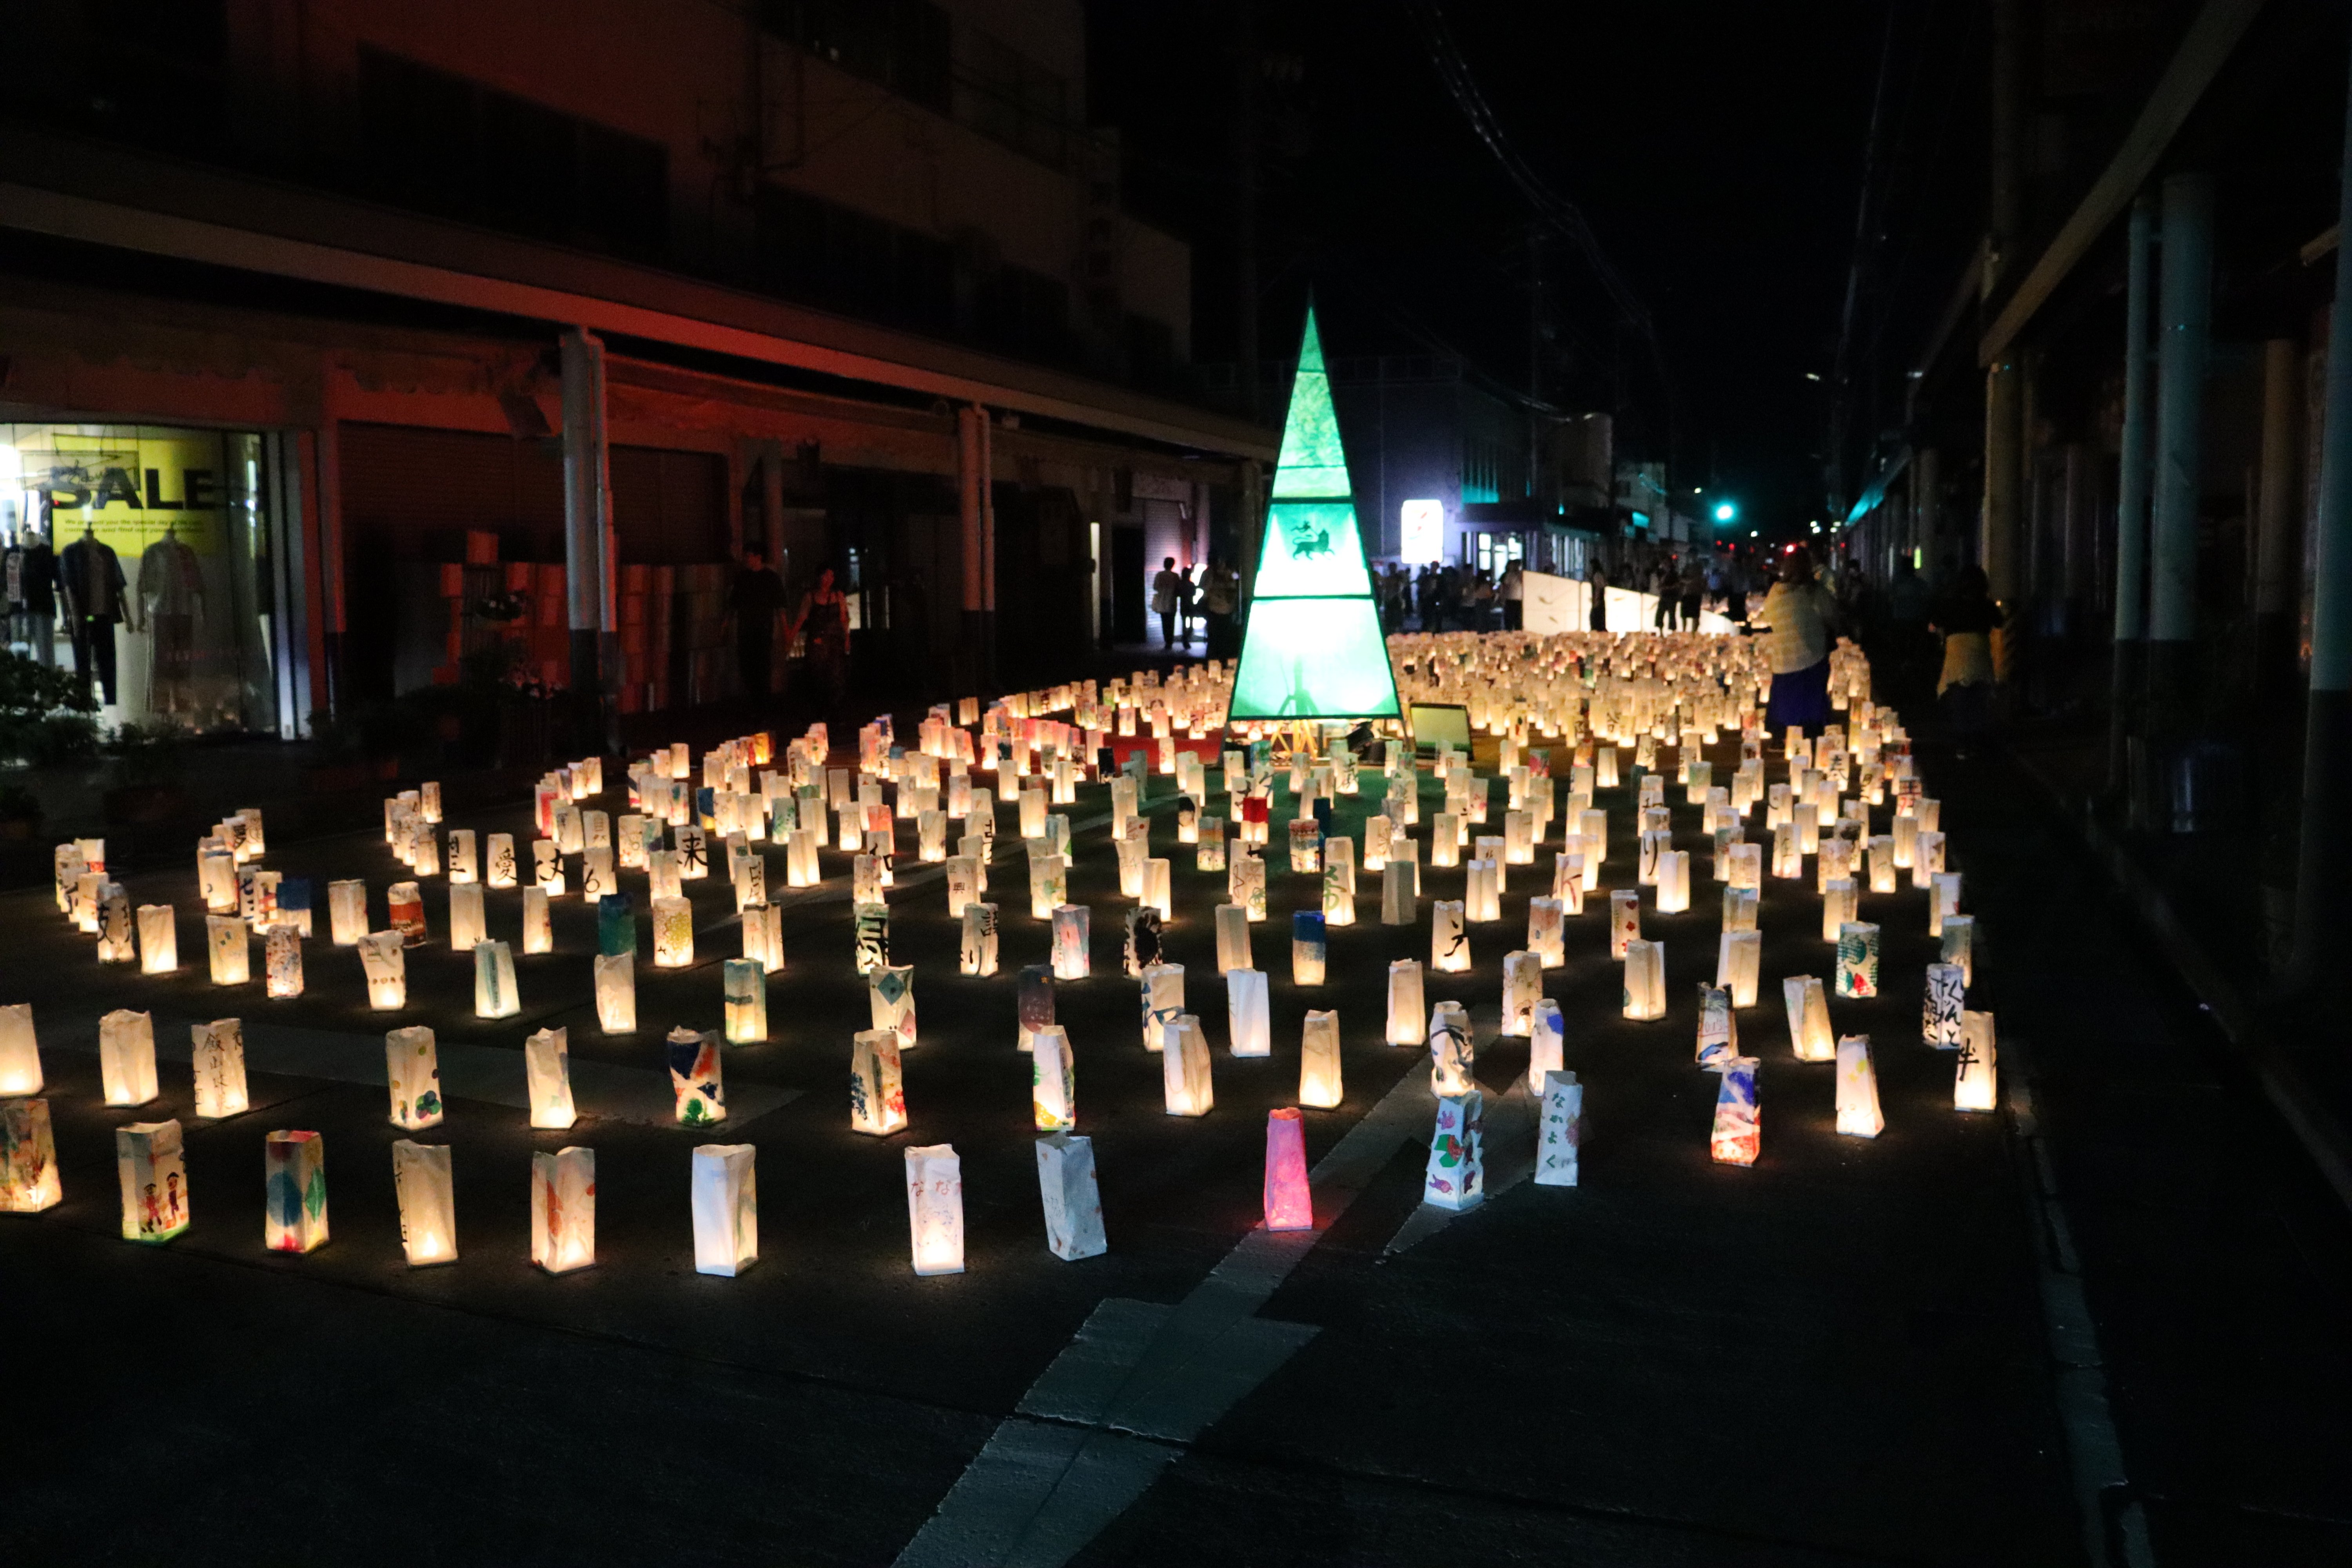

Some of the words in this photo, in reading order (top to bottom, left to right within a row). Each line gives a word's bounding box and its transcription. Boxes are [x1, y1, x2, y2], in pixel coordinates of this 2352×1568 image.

[51, 467, 215, 510] SALE
[495, 847, 517, 881] 愛
[682, 832, 708, 871] 来
[1546, 1092, 1565, 1169] なかよく
